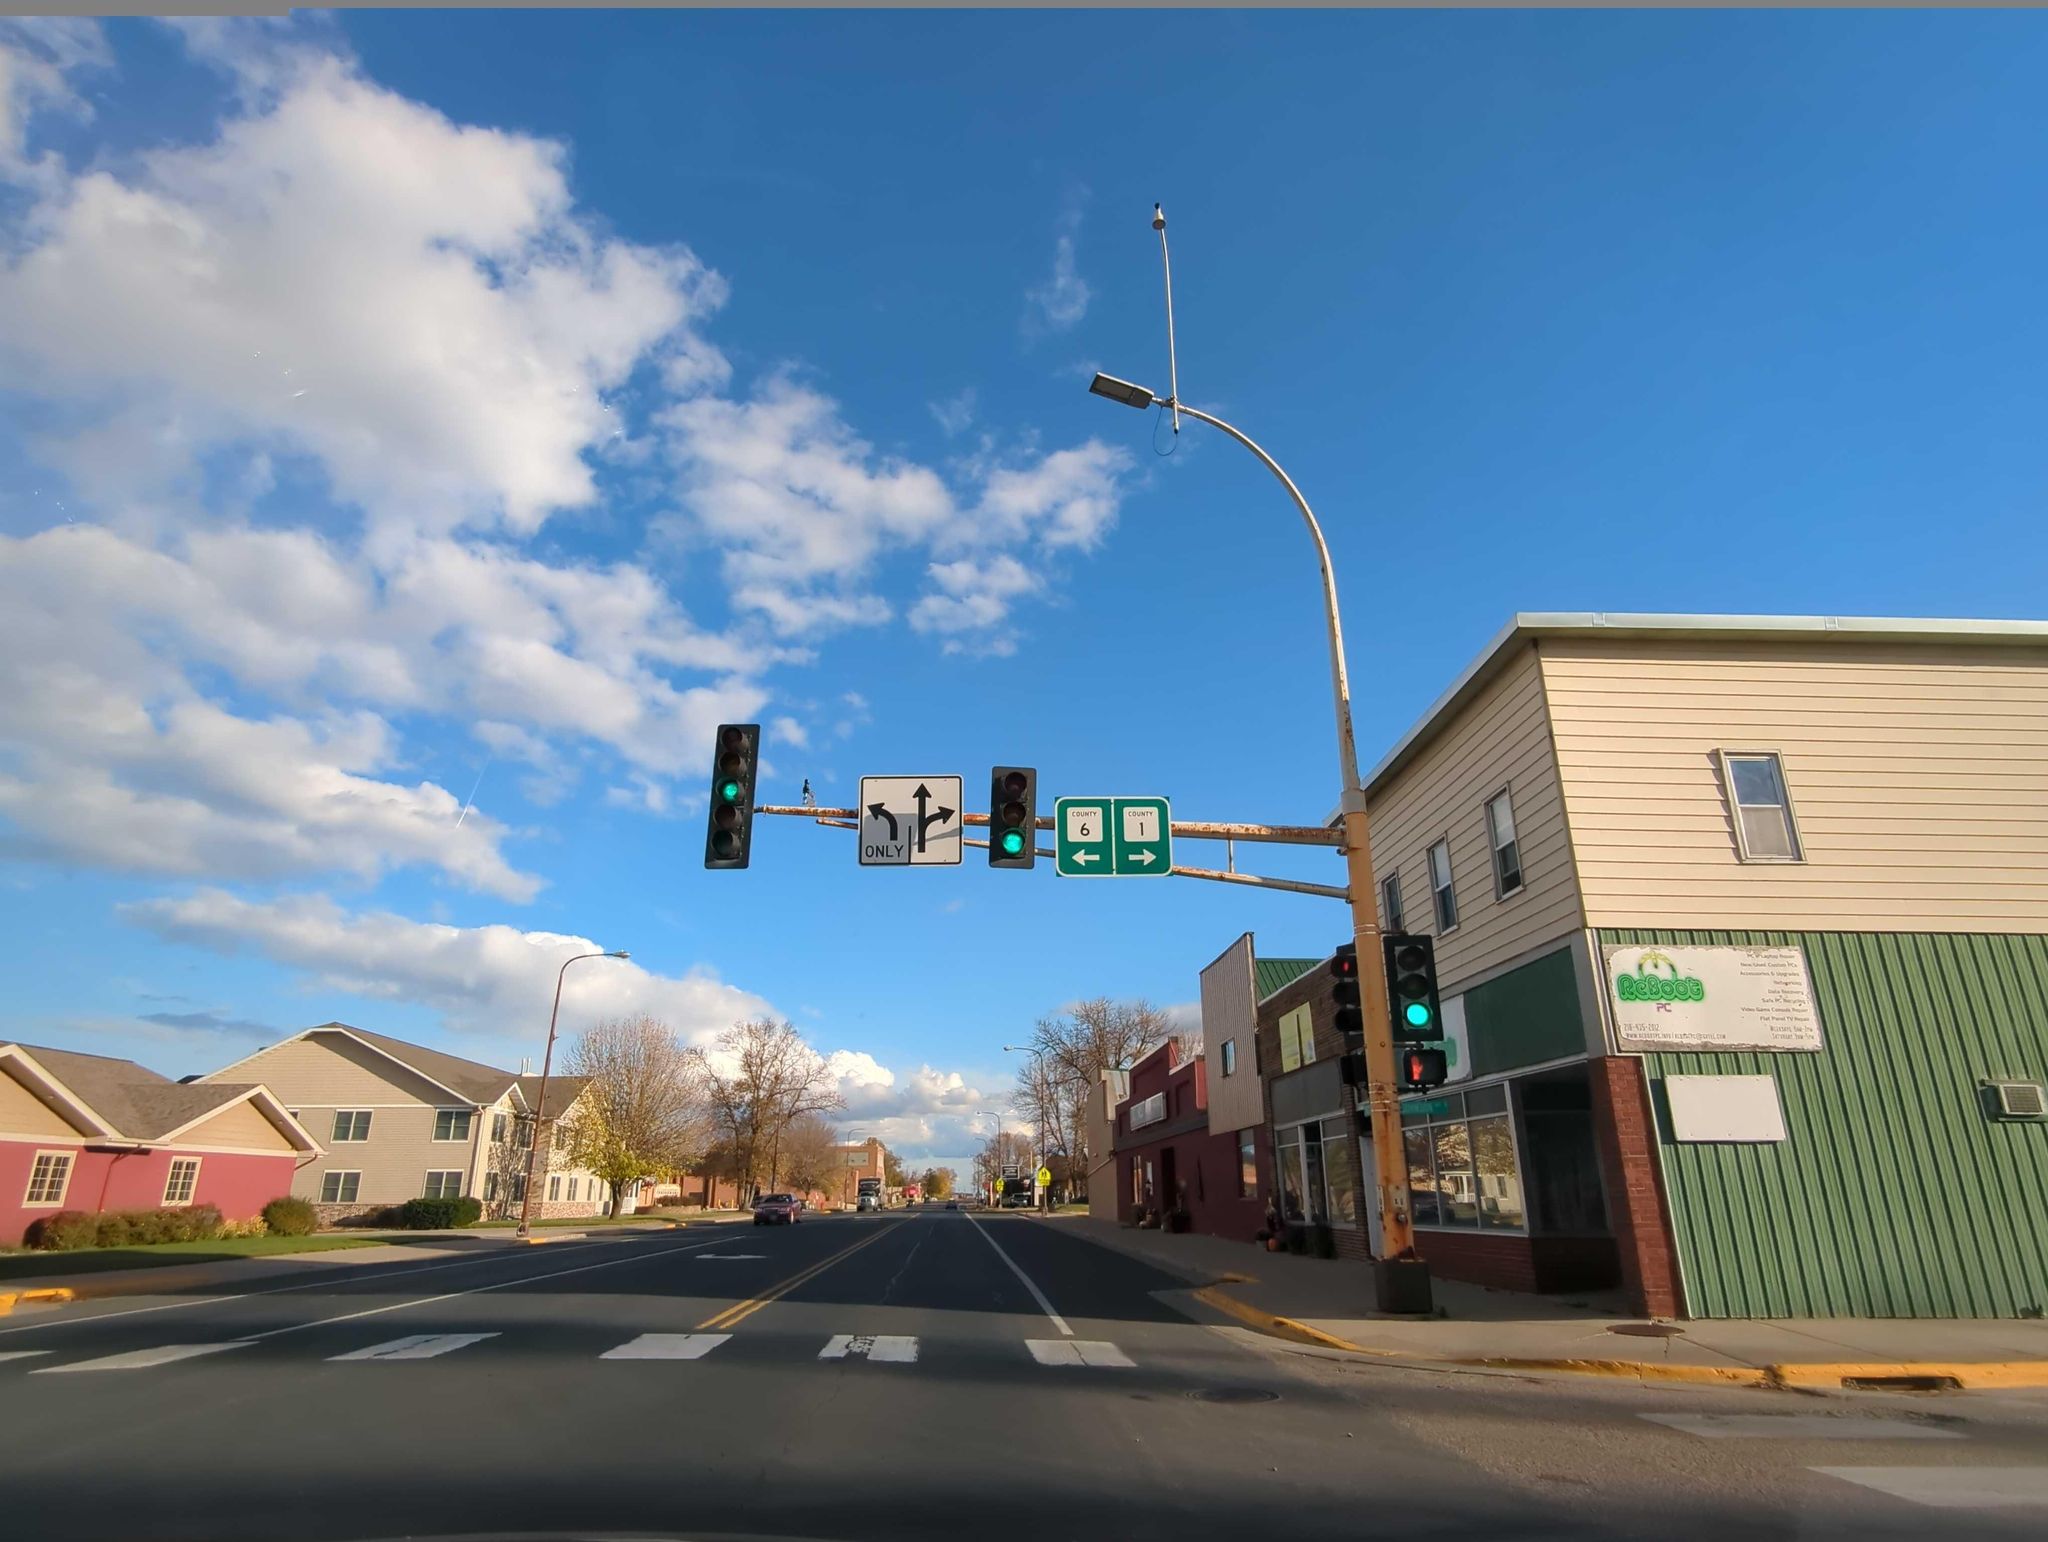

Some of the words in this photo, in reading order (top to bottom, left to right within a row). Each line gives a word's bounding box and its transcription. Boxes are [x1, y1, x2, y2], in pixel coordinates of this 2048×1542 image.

[1080, 822, 1090, 837] 6
[1139, 821, 1144, 837] 1
[865, 844, 904, 858] ONLY
[1656, 1003, 1672, 1012] PC
